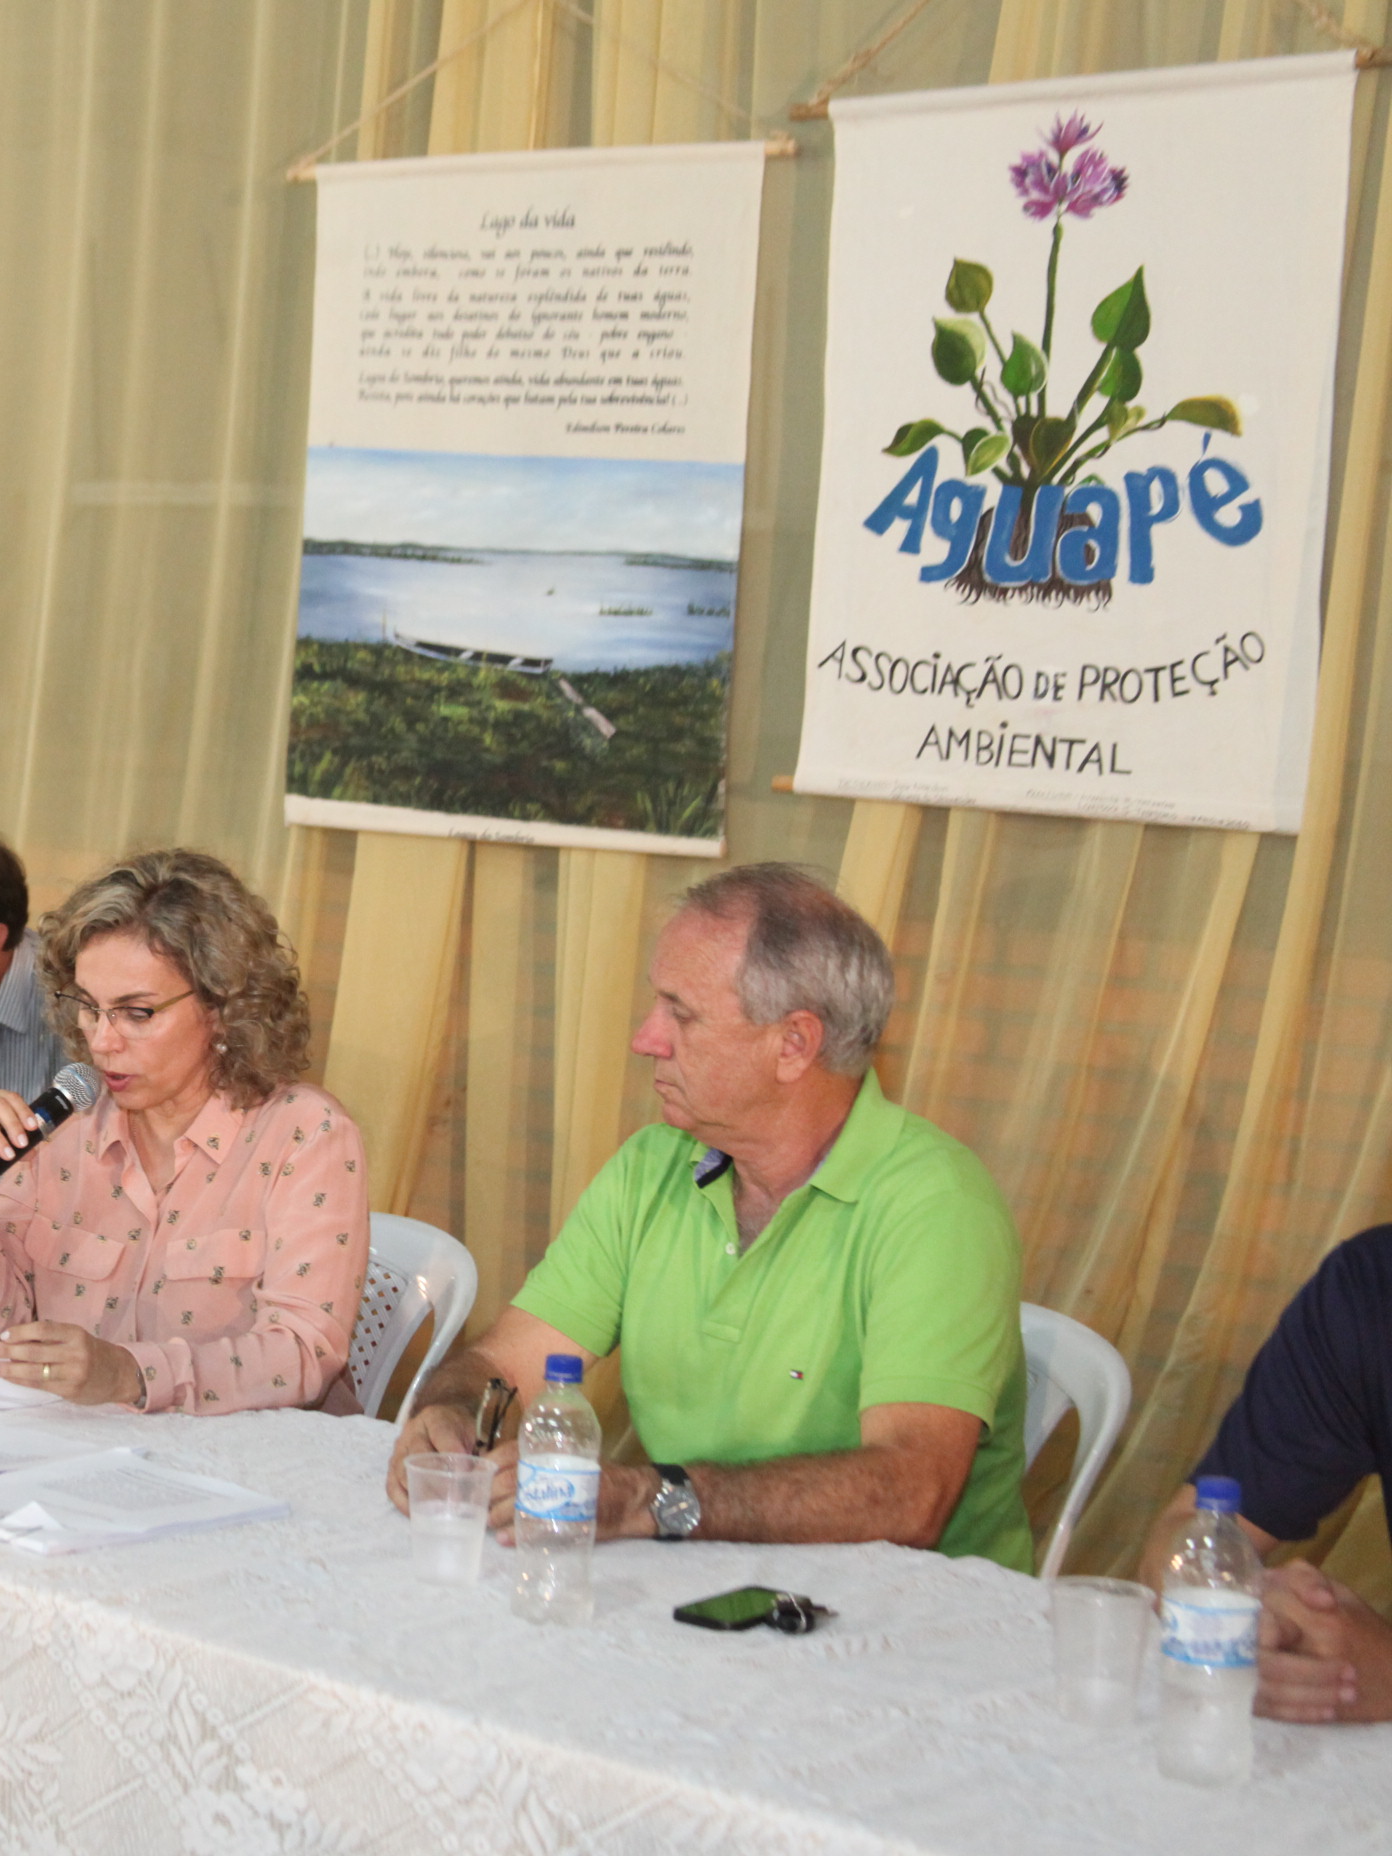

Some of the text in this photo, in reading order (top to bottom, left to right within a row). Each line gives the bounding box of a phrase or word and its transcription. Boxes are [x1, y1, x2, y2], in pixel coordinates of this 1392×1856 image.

[519, 204, 539, 229] da
[545, 204, 575, 229] vida
[576, 243, 606, 258] ainda
[615, 247, 634, 261] que
[592, 305, 629, 320] homem
[600, 349, 621, 363] que
[529, 371, 550, 386] vida
[862, 432, 1262, 584] Aguapé
[818, 631, 1264, 707] ASSOCIAÇÃO DE PROTEÇÃO
[916, 721, 1132, 774] AMBIENTAL
